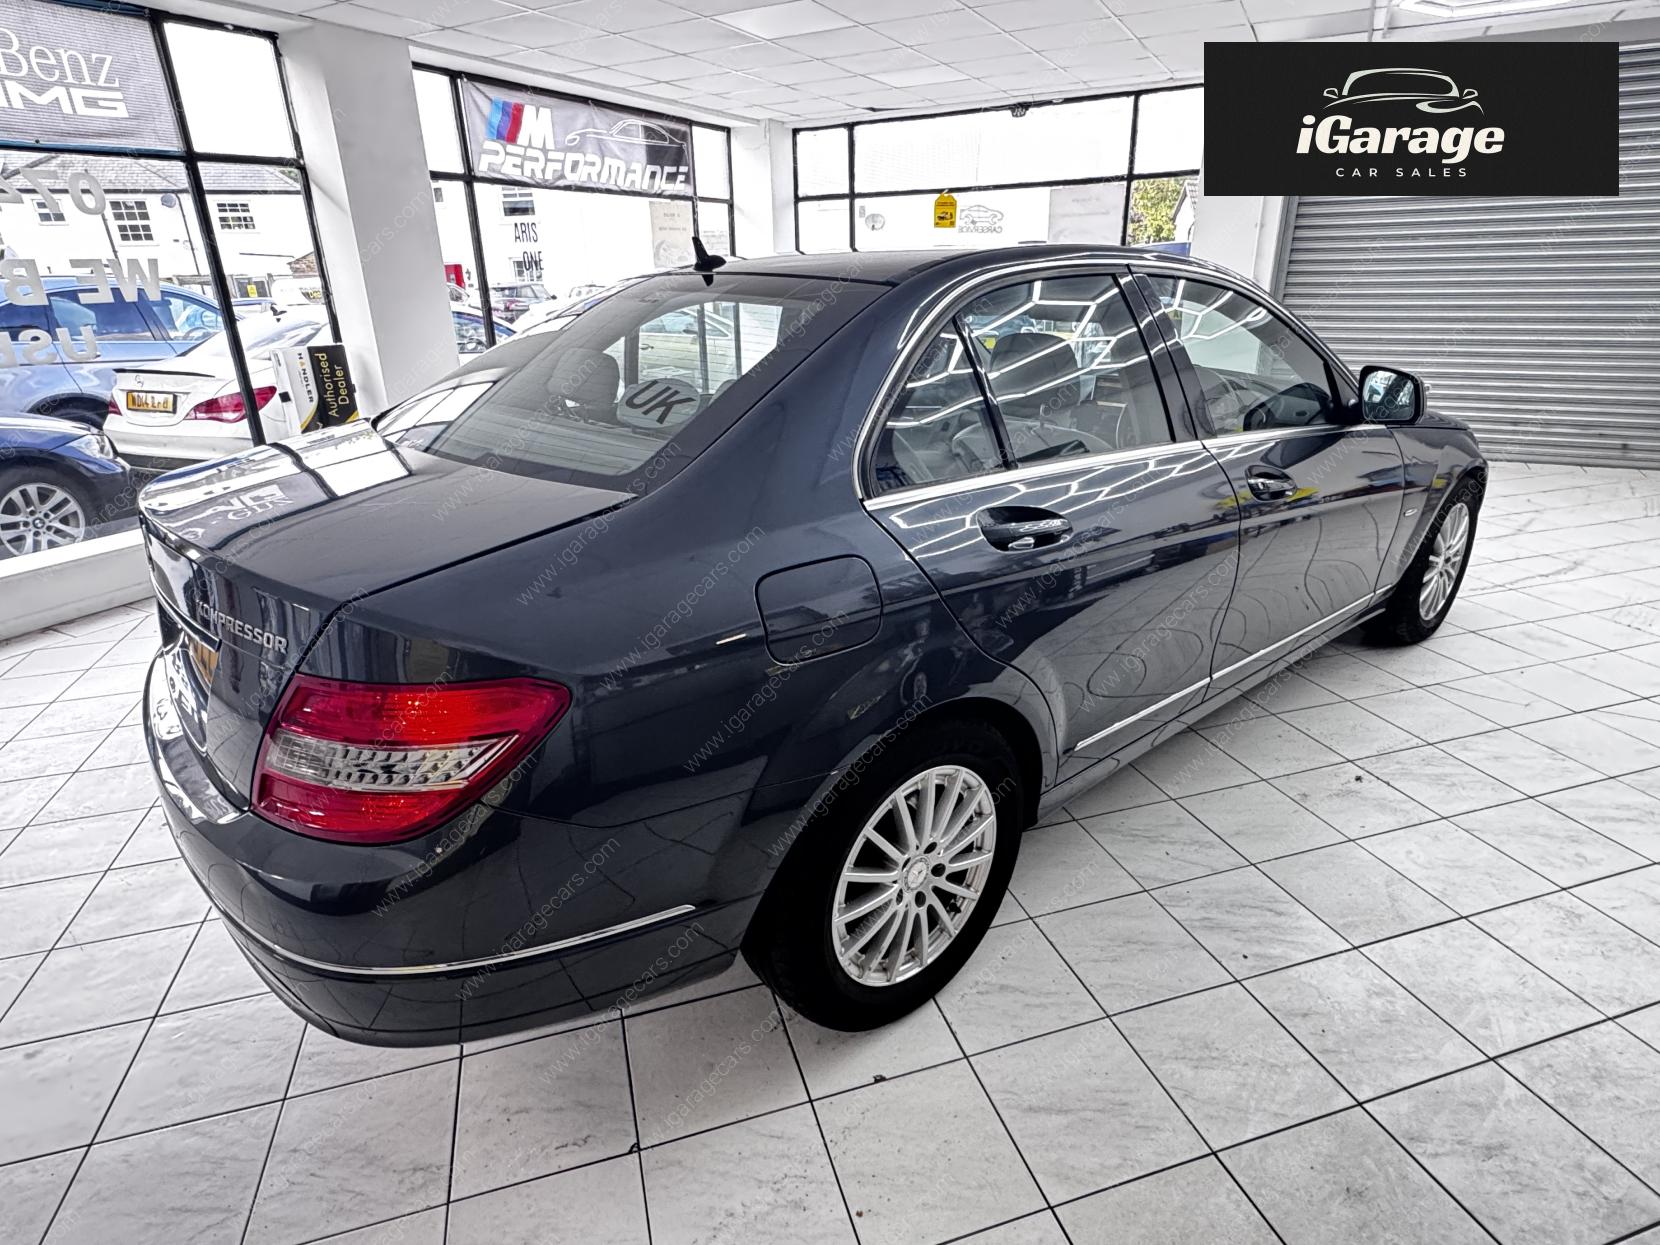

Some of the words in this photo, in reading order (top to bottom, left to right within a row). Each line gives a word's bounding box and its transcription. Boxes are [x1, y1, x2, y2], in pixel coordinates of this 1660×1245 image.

[478, 141, 689, 191] PERFORMANCE
[514, 222, 539, 243] ARIS
[522, 251, 545, 272] ONE
[314, 352, 340, 418] Authorised
[332, 364, 350, 405] Dealer
[625, 380, 696, 425] UK
[194, 599, 288, 655] KOMPRESSOR
